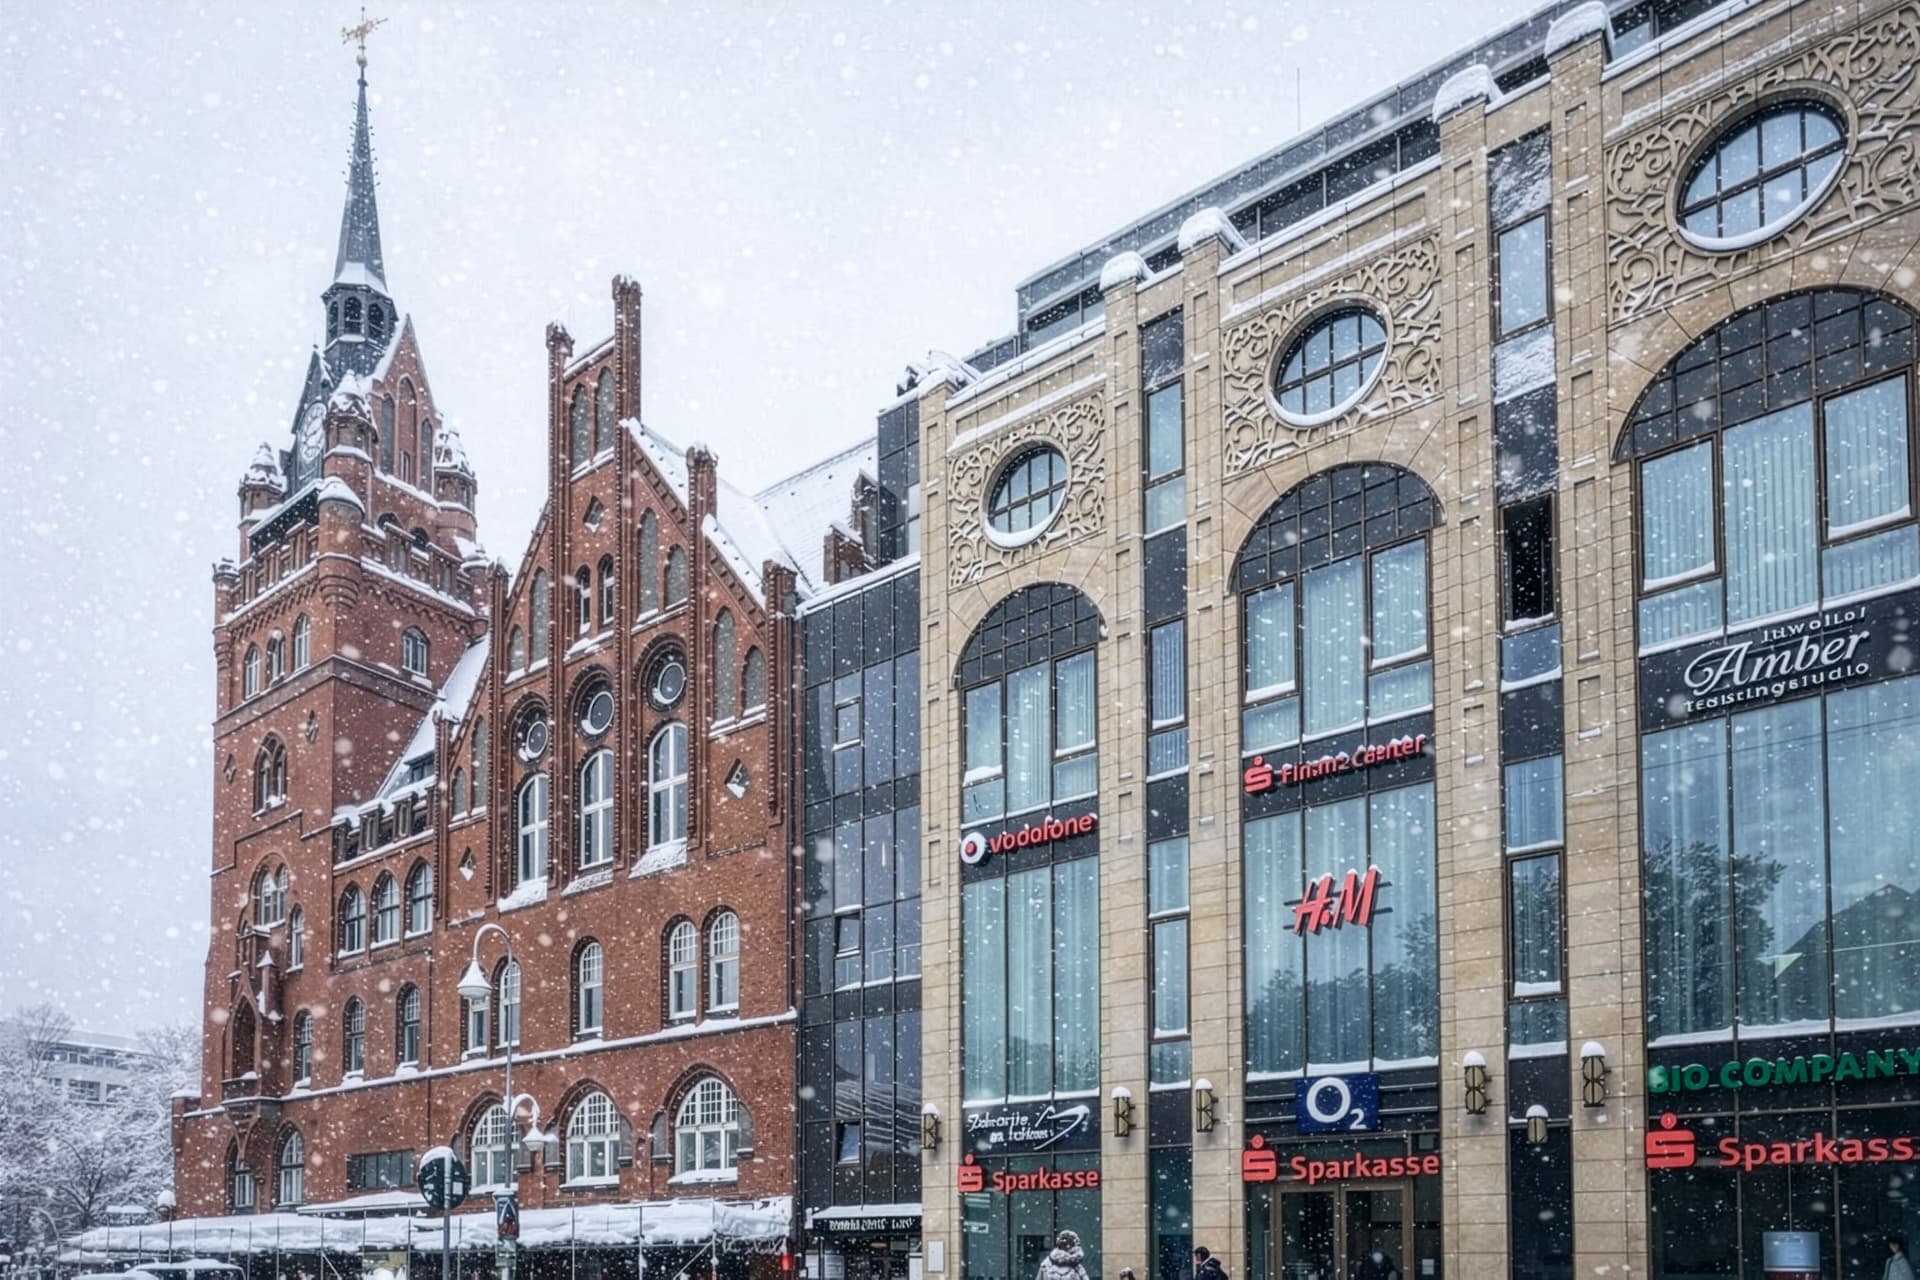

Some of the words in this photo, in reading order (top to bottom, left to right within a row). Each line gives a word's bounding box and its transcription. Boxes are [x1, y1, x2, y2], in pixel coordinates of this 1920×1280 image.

[1684, 630, 1870, 696] Amber
[1649, 1064, 1710, 1093] BIO
[1720, 1048, 1920, 1090] COMPANY
[1291, 1152, 1440, 1185] Sparkasse
[1718, 1132, 1920, 1172] Sparkass
[992, 1166, 1100, 1195] Sparkasse
